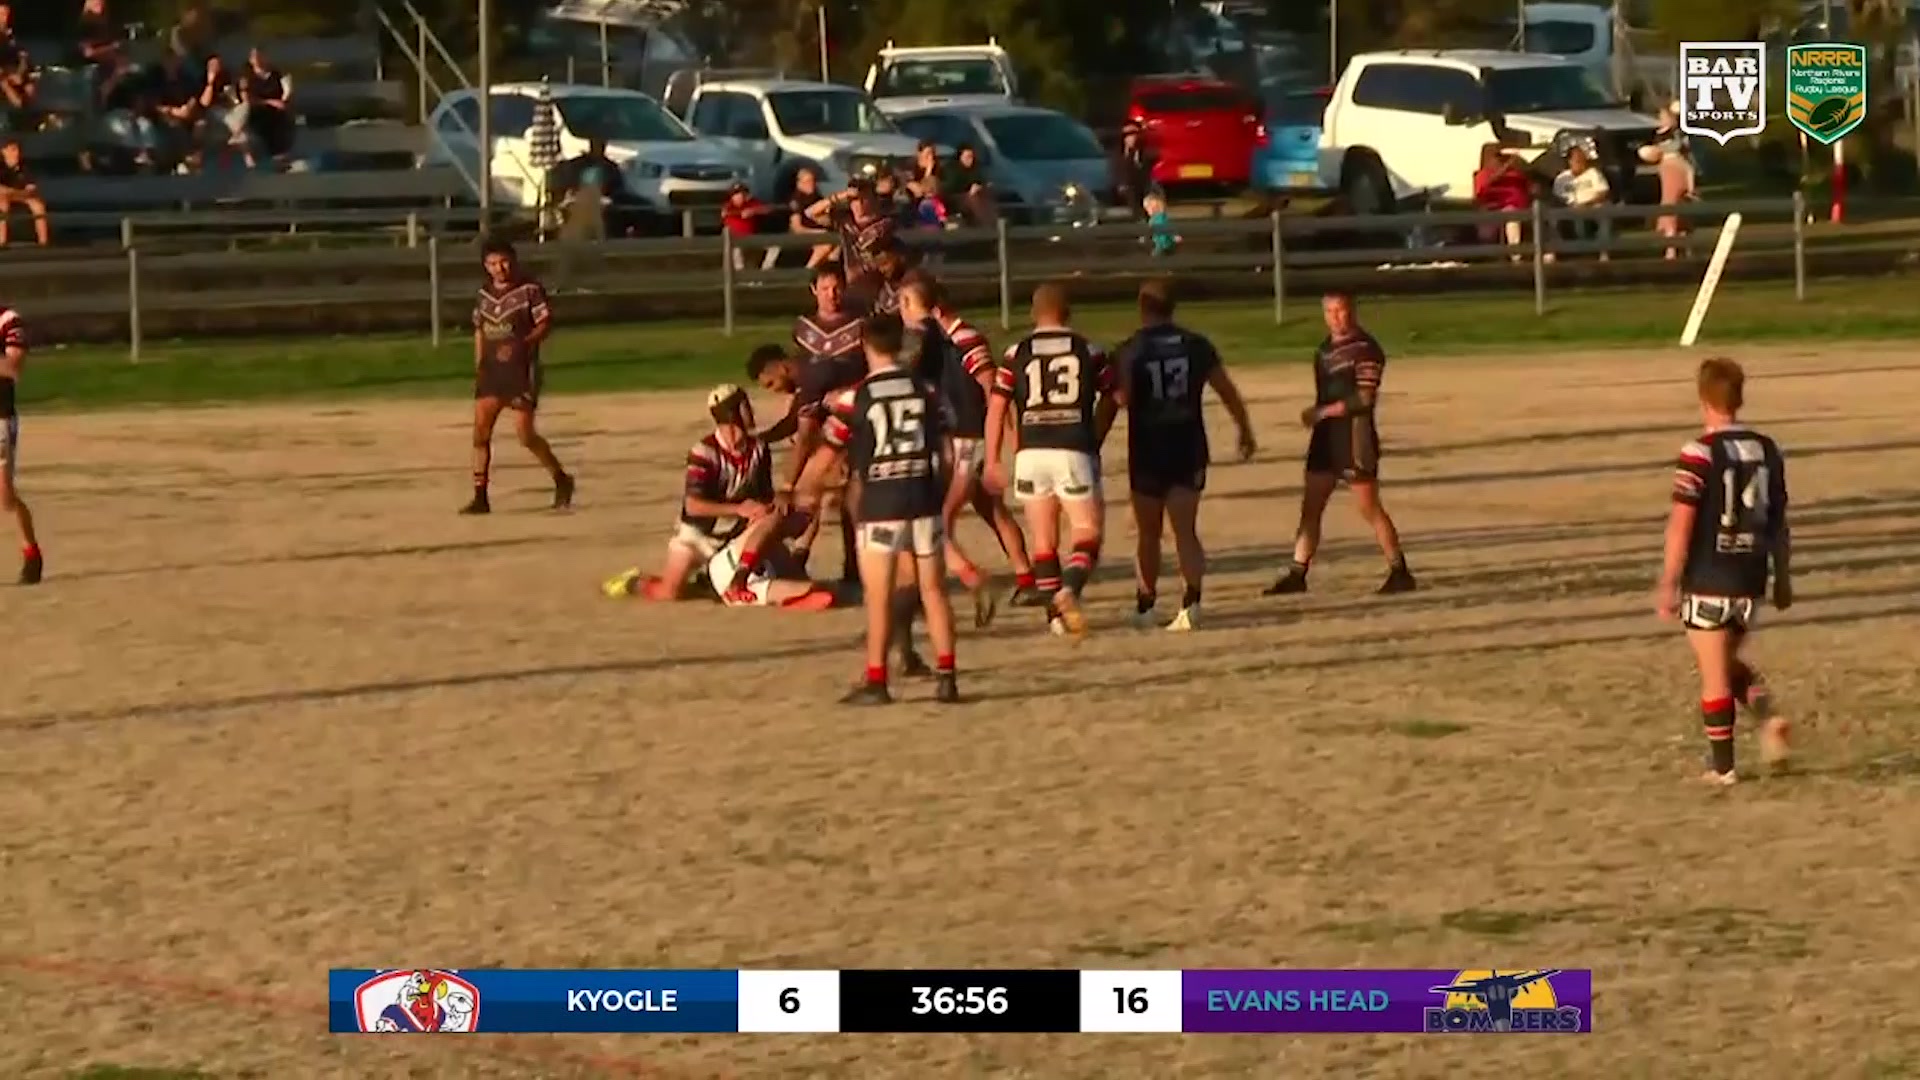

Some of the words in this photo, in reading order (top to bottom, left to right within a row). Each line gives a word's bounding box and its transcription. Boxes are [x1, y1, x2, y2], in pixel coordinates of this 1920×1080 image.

[1025, 354, 1080, 408] 13
[865, 398, 925, 458] 15
[1720, 465, 1770, 527] 14
